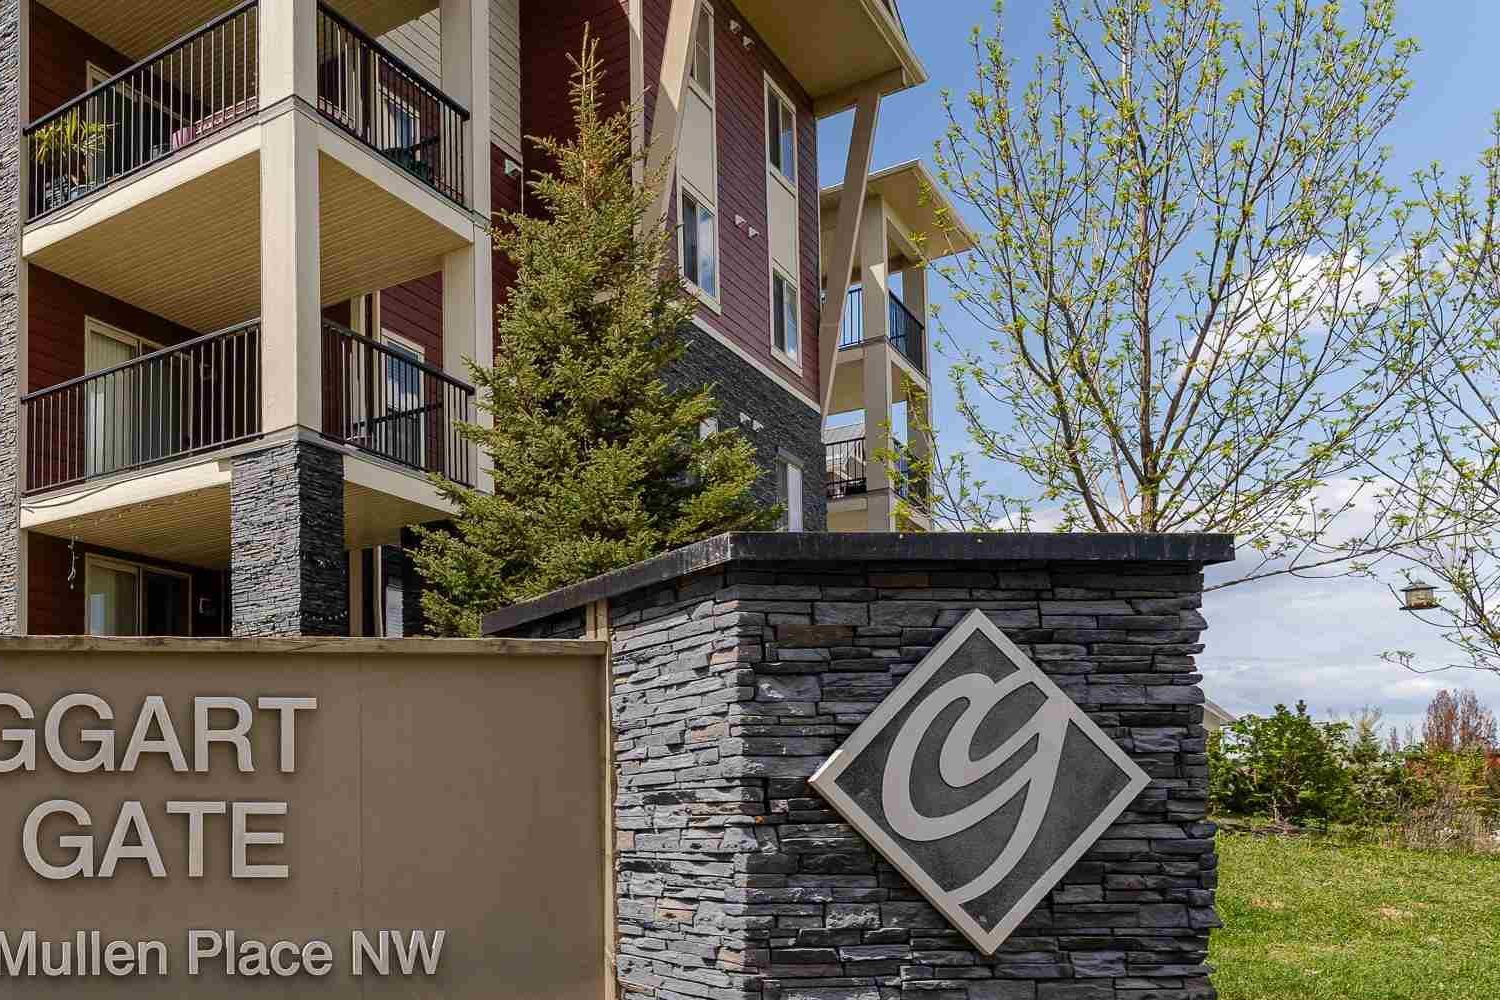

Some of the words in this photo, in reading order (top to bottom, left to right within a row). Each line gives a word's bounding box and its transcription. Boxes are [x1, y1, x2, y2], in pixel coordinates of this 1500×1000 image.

[21, 799, 290, 880] GATE
[187, 928, 334, 977] Place
[351, 928, 447, 976] NW
